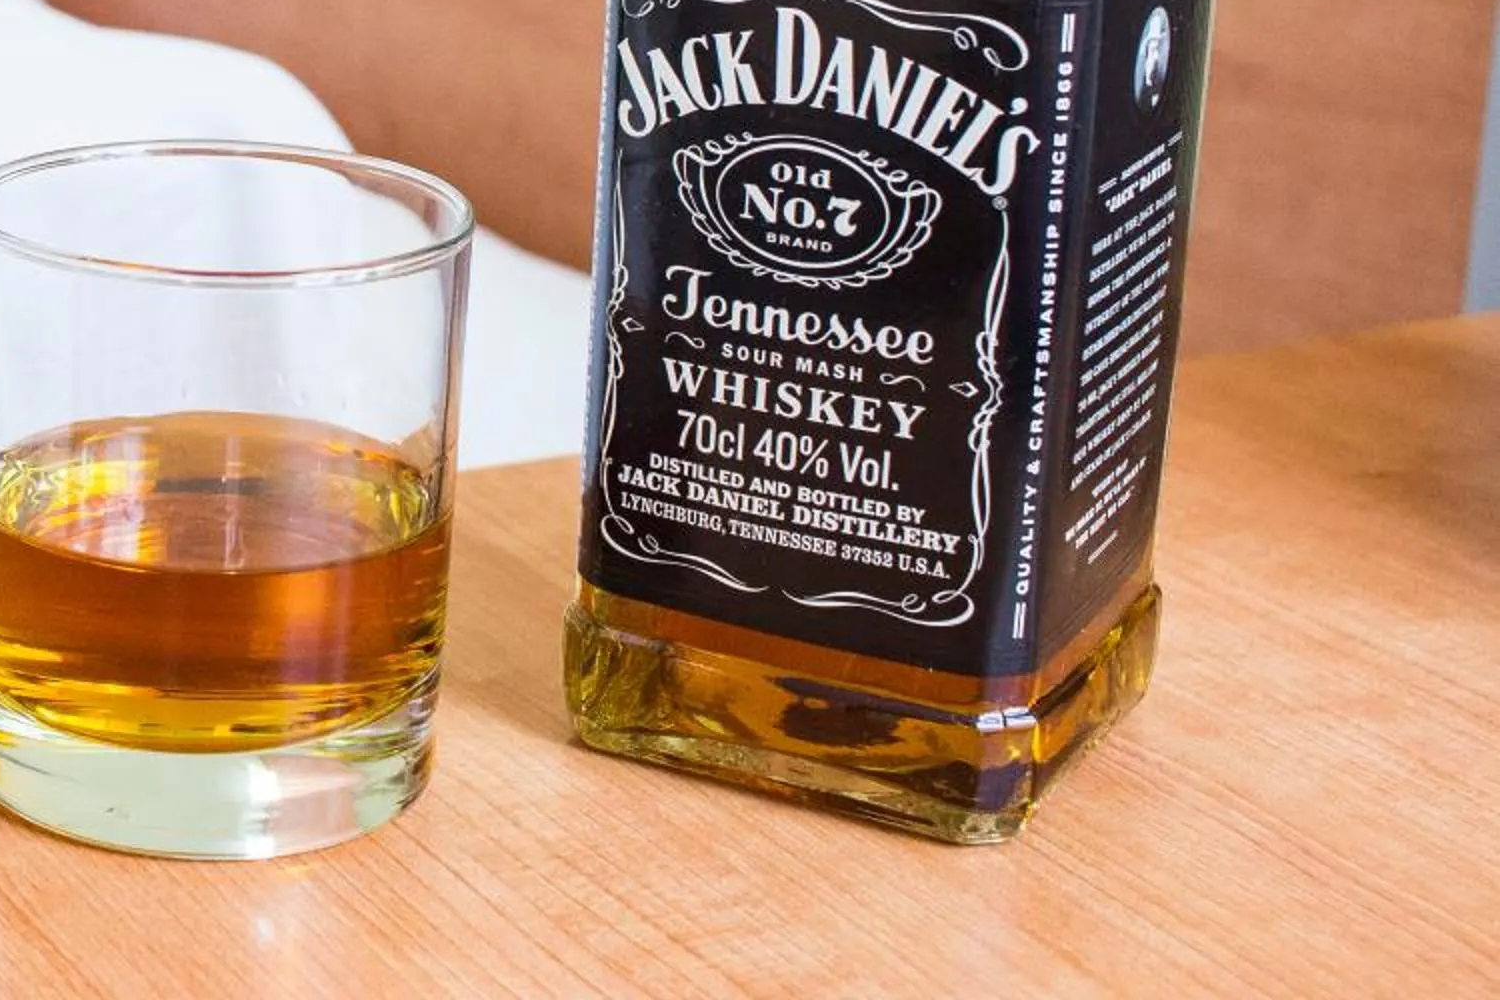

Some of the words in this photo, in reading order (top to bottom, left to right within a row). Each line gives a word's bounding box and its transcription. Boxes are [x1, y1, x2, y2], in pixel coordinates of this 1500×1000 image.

[617, 29, 766, 138] JACK
[773, 7, 1042, 196] DANIEL'S
[1055, 60, 1074, 122] 1866
[770, 161, 832, 189] Old
[1047, 131, 1068, 213] SINCE
[765, 231, 833, 252] BRAND
[661, 265, 934, 365] Tennessee
[1028, 223, 1061, 450] CRAFTSMANSHIP
[661, 356, 927, 440] WHISKEY
[720, 343, 784, 369] SOUR
[795, 356, 864, 382] MASH
[650, 453, 745, 489] DISTILLED
[749, 477, 792, 499] AND
[797, 485, 891, 518] BOTTLED
[896, 504, 927, 525] BY
[677, 409, 745, 461] 70cl
[753, 428, 830, 479] 40%
[838, 442, 900, 492] Vol.
[1032, 458, 1041, 475] &
[617, 464, 682, 497] JACK
[686, 481, 785, 521] DANIEL
[791, 504, 962, 555] DISTILLERY
[620, 491, 727, 536] LYNCHBURG,
[727, 518, 837, 558] TENNESSEE
[841, 543, 894, 568] 37352
[897, 553, 952, 580] U.S.A.
[1015, 485, 1038, 595] QUALITY
